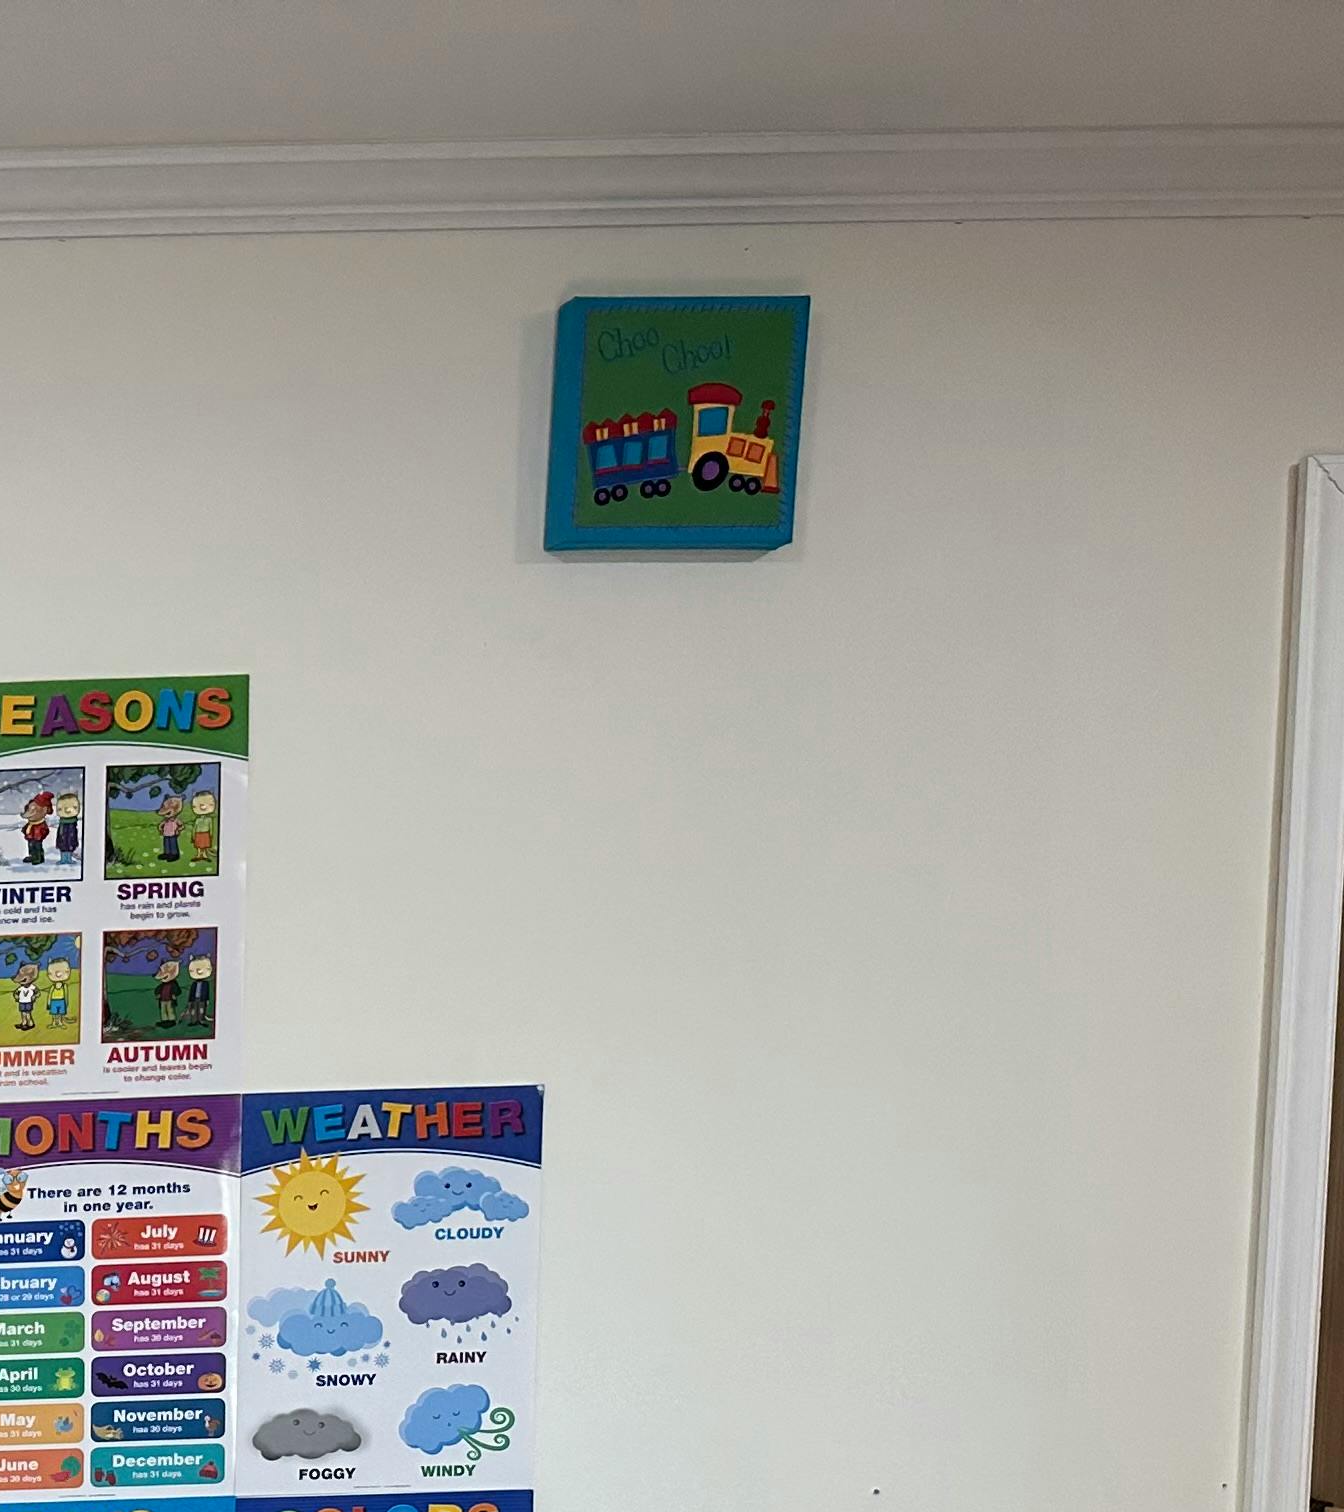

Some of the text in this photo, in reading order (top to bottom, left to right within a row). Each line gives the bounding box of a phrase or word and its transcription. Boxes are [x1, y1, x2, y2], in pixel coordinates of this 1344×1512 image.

[598, 327, 732, 375] Choo Choo!
[117, 881, 204, 901] SPRING
[24, 906, 40, 915] and
[107, 1044, 208, 1064] AUTUMN
[261, 1100, 526, 1144] WEATHER
[26, 1182, 191, 1201] There are 12 months
[63, 1200, 154, 1215] in one year.
[141, 1224, 178, 1241] July
[435, 1226, 504, 1241] CLOUDY
[134, 1240, 184, 1252] has 31 days
[332, 1250, 390, 1263] SUNNY
[436, 1351, 487, 1364] RAINY
[315, 1373, 377, 1387] SNOWY
[298, 1467, 357, 1480] FOGGY
[420, 1464, 476, 1477] WINDY
